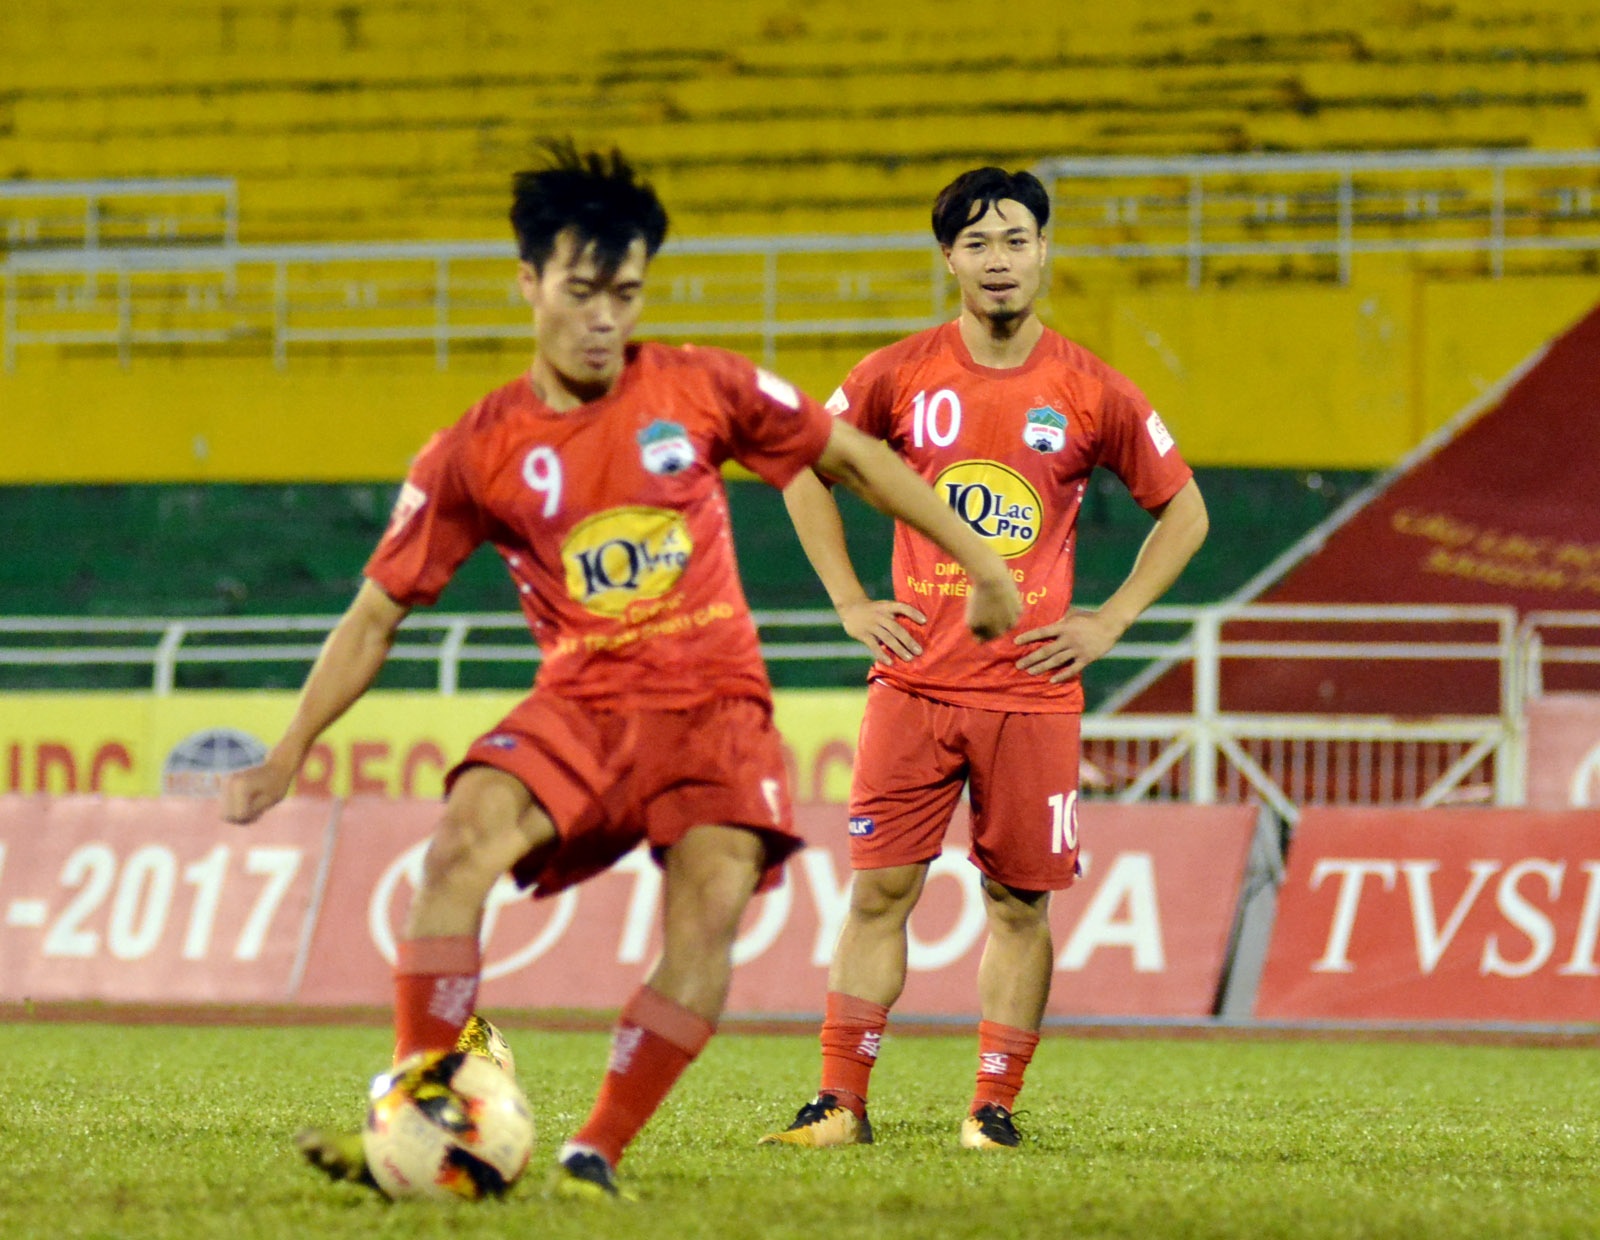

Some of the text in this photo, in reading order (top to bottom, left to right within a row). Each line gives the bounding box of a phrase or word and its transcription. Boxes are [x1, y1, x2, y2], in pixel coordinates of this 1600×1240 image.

[912, 389, 961, 448] 10
[522, 446, 562, 518] 9
[992, 494, 1033, 520] Lac
[996, 518, 1033, 540] Pro
[1048, 791, 1078, 853] 10
